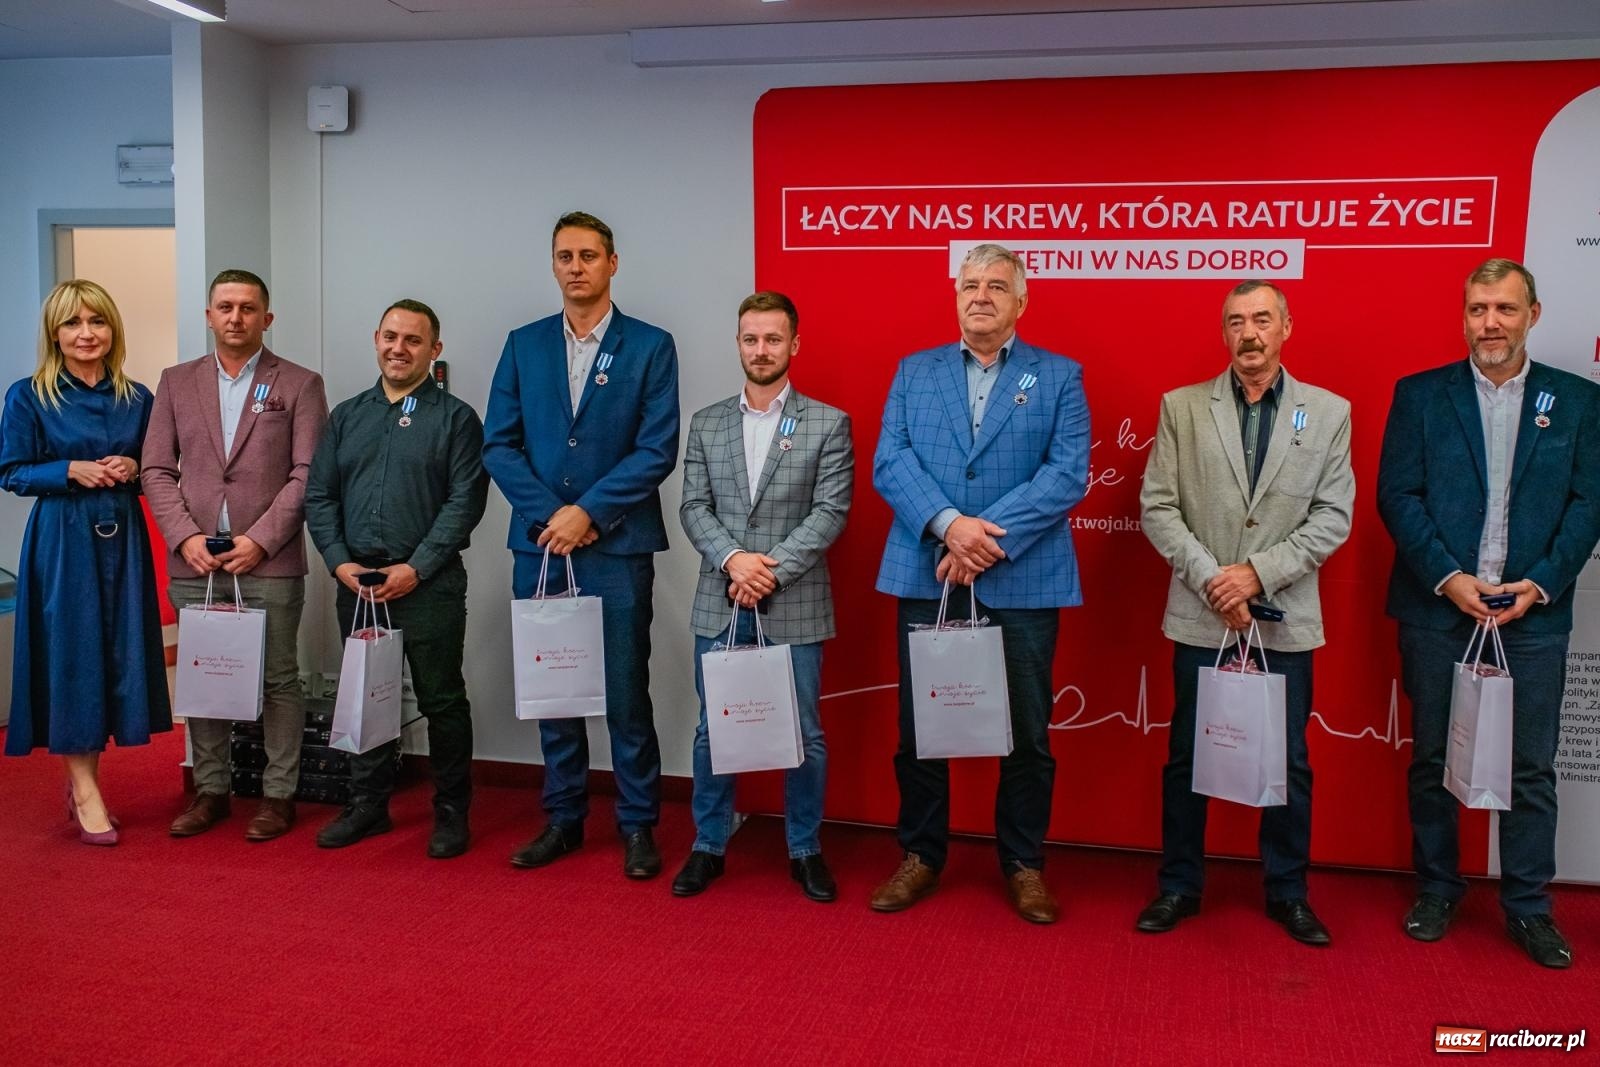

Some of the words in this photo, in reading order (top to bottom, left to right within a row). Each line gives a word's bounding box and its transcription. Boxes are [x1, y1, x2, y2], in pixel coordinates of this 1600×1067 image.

[800, 204, 900, 235] ŁĄCZY
[908, 203, 974, 229] NAS
[983, 202, 1088, 232] KREW,
[1099, 196, 1218, 229] KTÓRA
[1227, 199, 1359, 228] RATUJE
[1367, 192, 1475, 227] ŻYCIE
[1091, 250, 1119, 270] W
[1126, 249, 1179, 270] NAS
[1187, 249, 1289, 270] DOBRO
[1563, 687, 1599, 699] olityki
[1565, 736, 1593, 746] krew
[1571, 748, 1592, 758] lata
